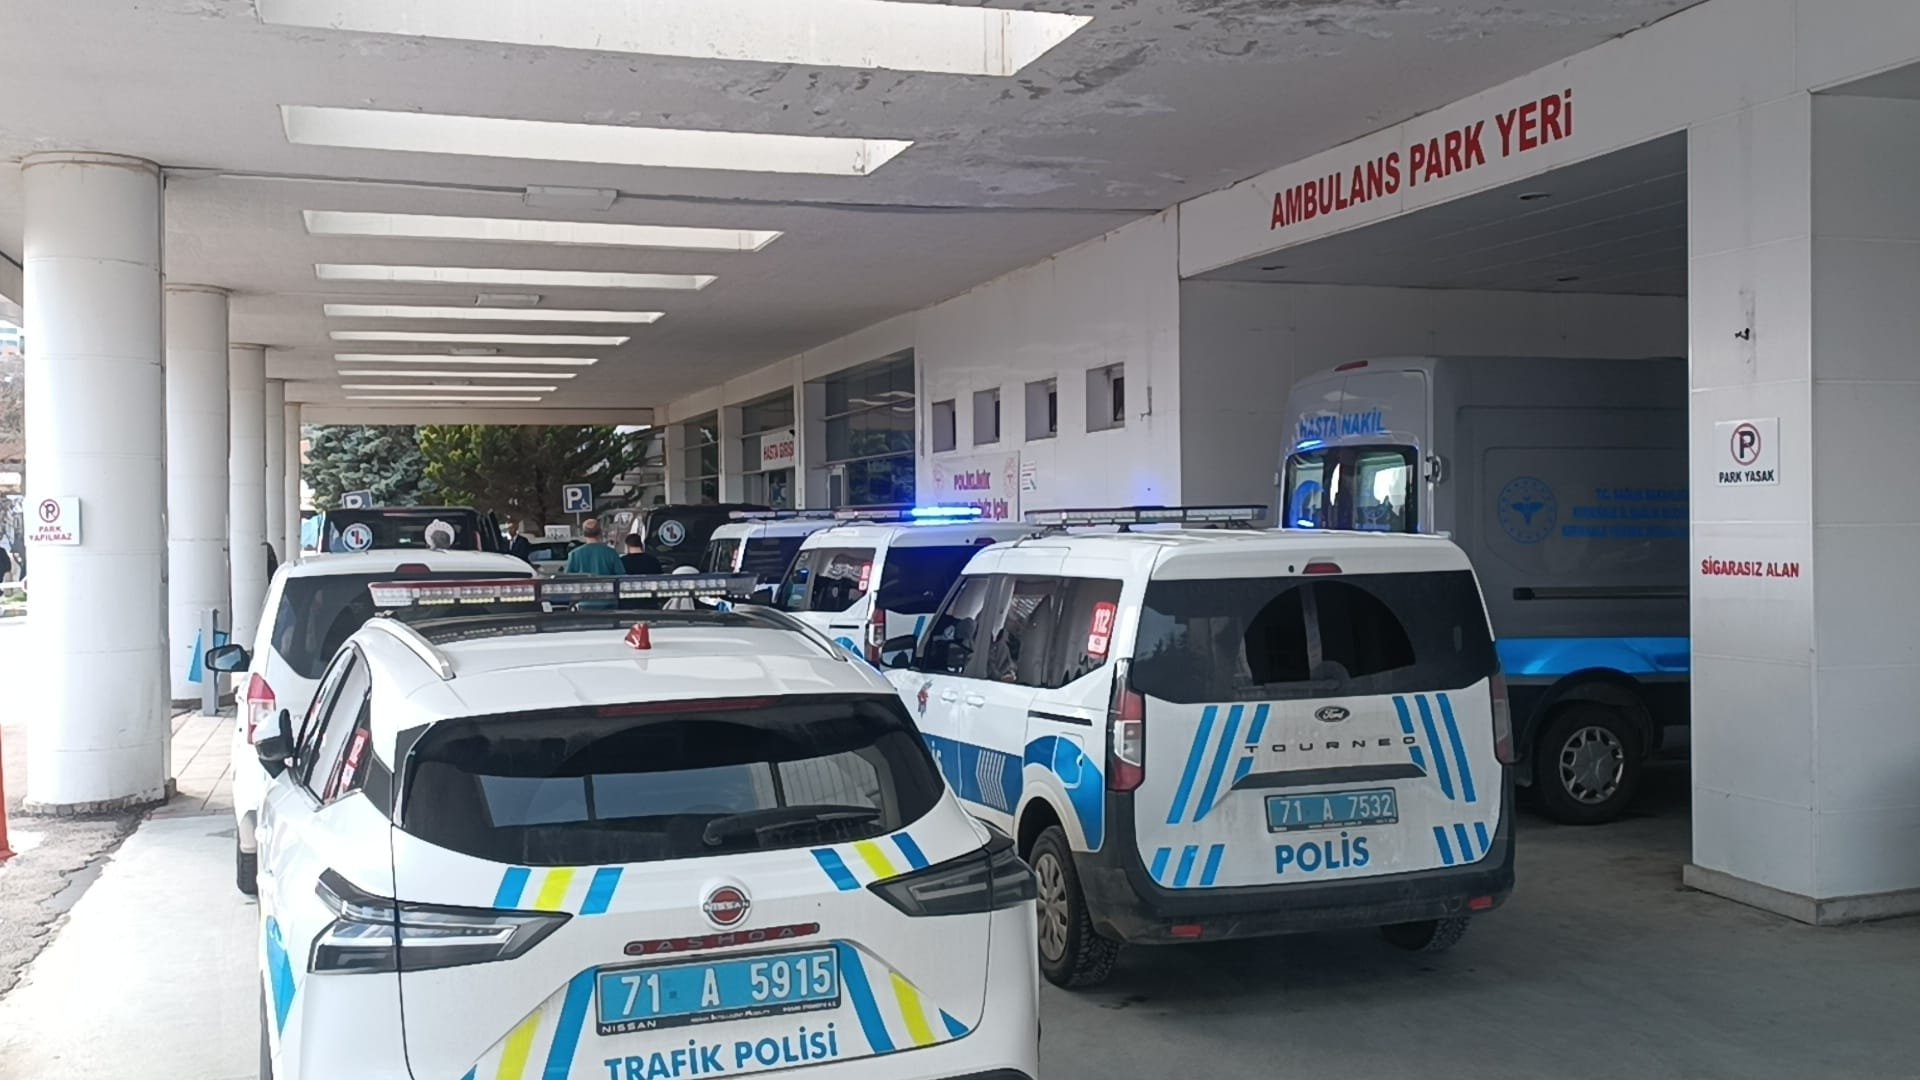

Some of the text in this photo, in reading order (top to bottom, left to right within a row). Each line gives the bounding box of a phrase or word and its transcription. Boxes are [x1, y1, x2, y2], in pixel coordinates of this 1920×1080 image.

[1271, 152, 1400, 231] AMBULANS
[1410, 120, 1486, 187] PARK
[1299, 406, 1387, 438] HASTA NAKİL
[1719, 469, 1775, 483] PARK YASAK
[567, 488, 583, 509] P
[29, 533, 72, 542] YAPILMAZ
[1701, 555, 1800, 578] SİGARASIZ ALAN
[1244, 736, 1417, 753] TOURNEO
[1279, 794, 1393, 824] 71 A 7532
[1275, 831, 1370, 874] POLİS
[703, 901, 750, 911] NISSAN
[620, 955, 832, 1016] 71 A 5915
[602, 1020, 657, 1033] NISSAN
[604, 1022, 838, 1080] TRAFİK POLİSİ
